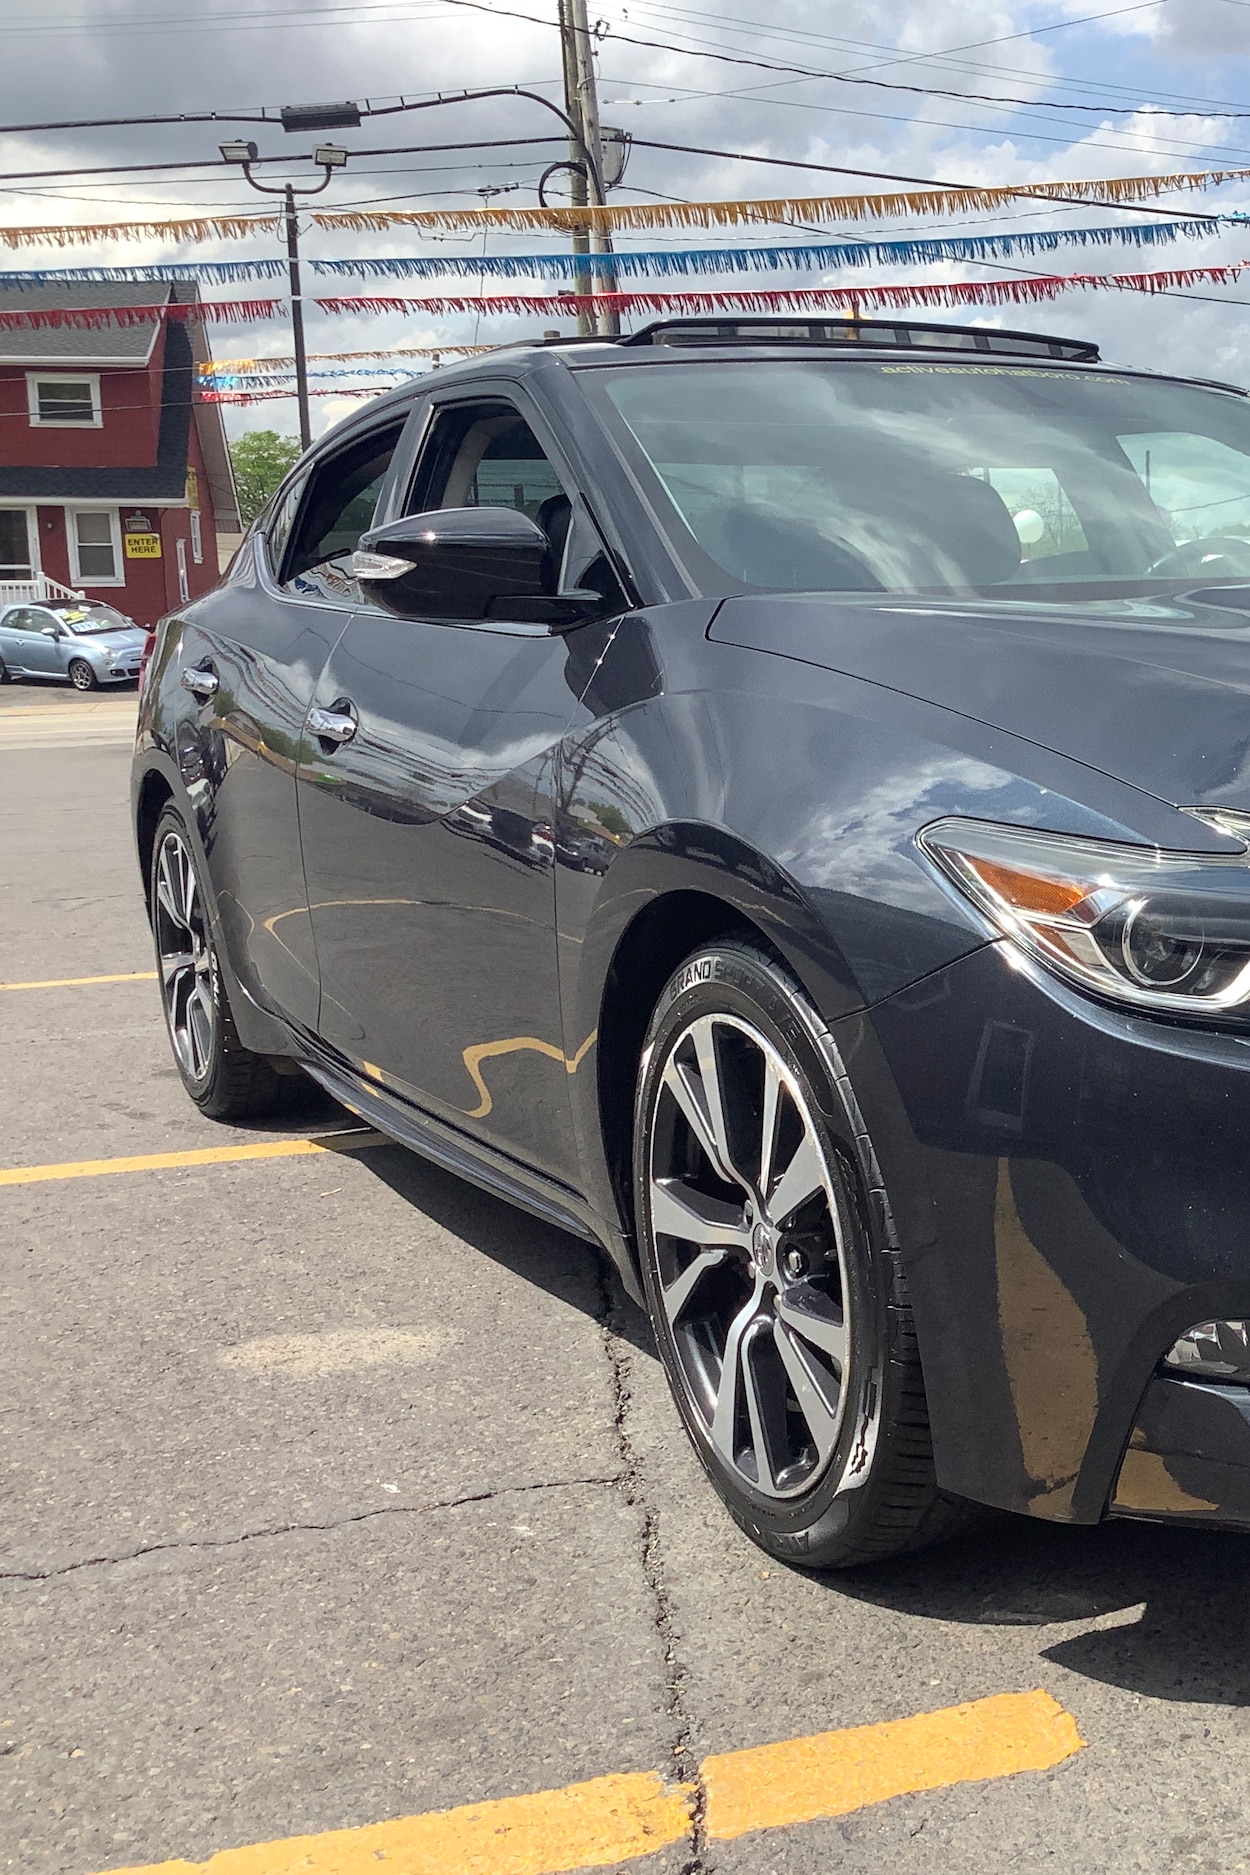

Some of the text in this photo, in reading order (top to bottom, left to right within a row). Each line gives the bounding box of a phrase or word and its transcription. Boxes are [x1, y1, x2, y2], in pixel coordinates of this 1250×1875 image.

[880, 364, 1131, 386] activeautohatboro.com
[127, 538, 158, 546] ENTER
[131, 545, 157, 553] HERE
